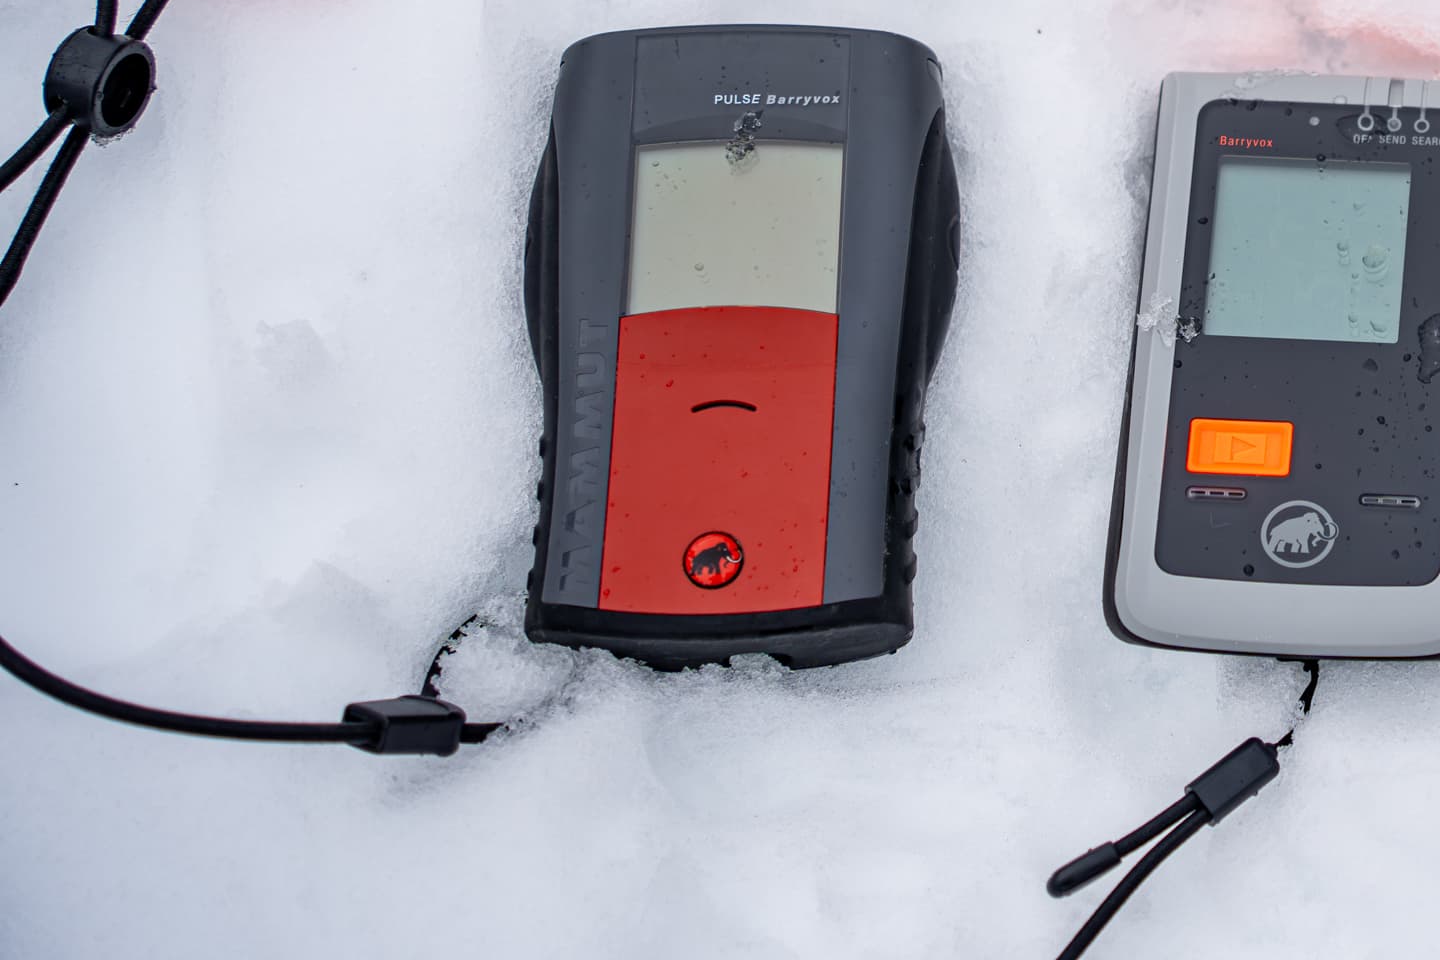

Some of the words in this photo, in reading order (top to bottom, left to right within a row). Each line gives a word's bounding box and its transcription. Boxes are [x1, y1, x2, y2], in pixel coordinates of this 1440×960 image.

[714, 94, 761, 105] PULSE
[766, 94, 840, 106] Barryvox
[1220, 135, 1273, 149] Barryvox
[1379, 134, 1407, 145] SEND
[559, 317, 609, 591] MAMMUT
